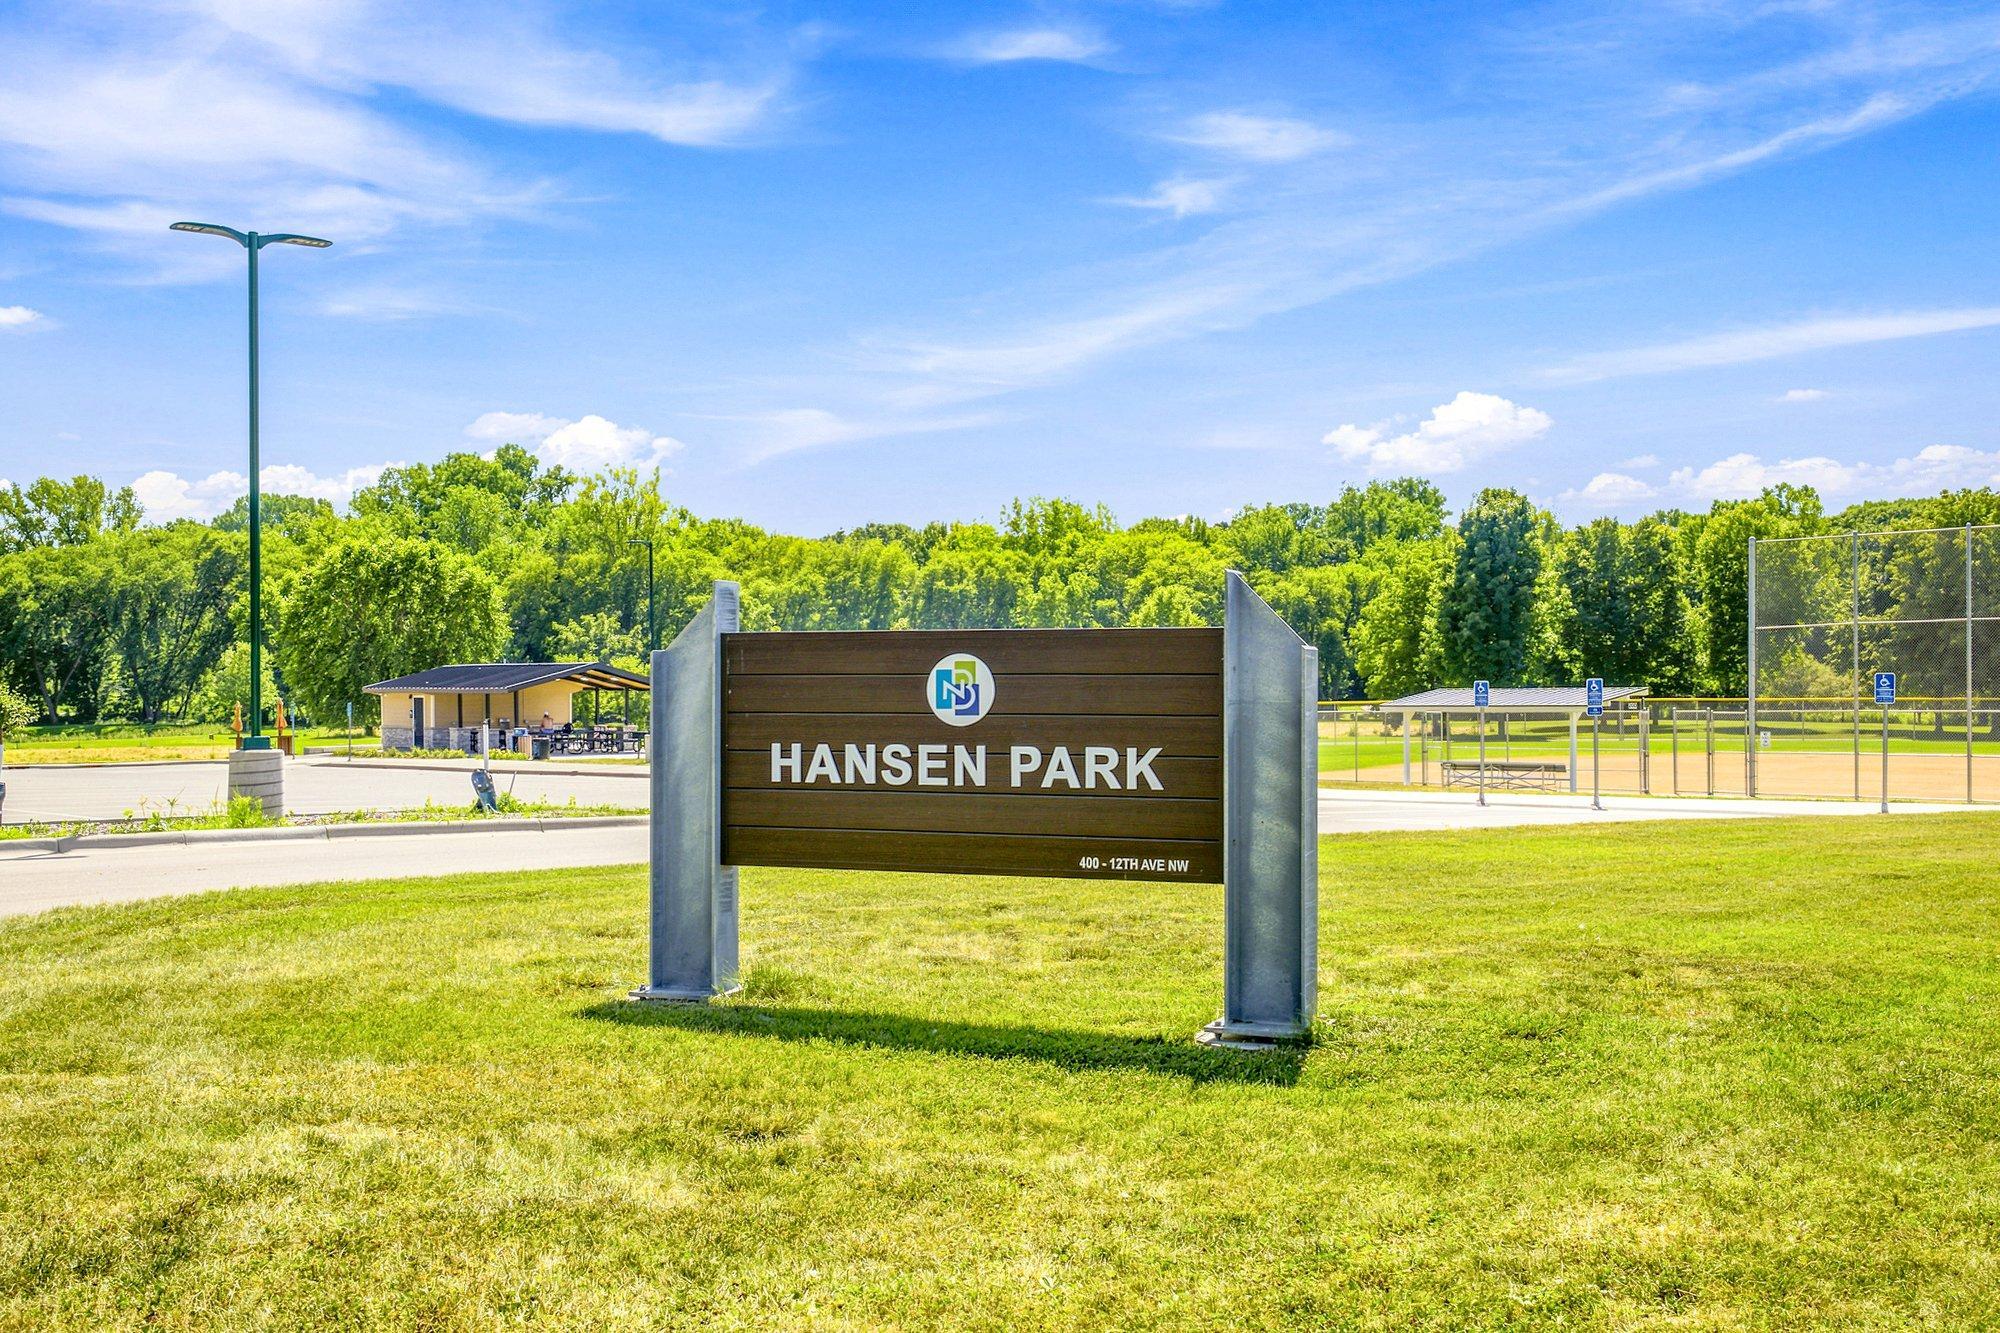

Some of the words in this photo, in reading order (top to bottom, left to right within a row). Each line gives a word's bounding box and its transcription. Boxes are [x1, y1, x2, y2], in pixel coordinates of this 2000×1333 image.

[769, 742, 986, 787] HANSEN
[1009, 745, 1165, 791] PARK
[1079, 857, 1099, 869] 400
[1109, 858, 1139, 870] 12TH
[1140, 859, 1165, 871] AVE
[1168, 860, 1189, 872] NW
